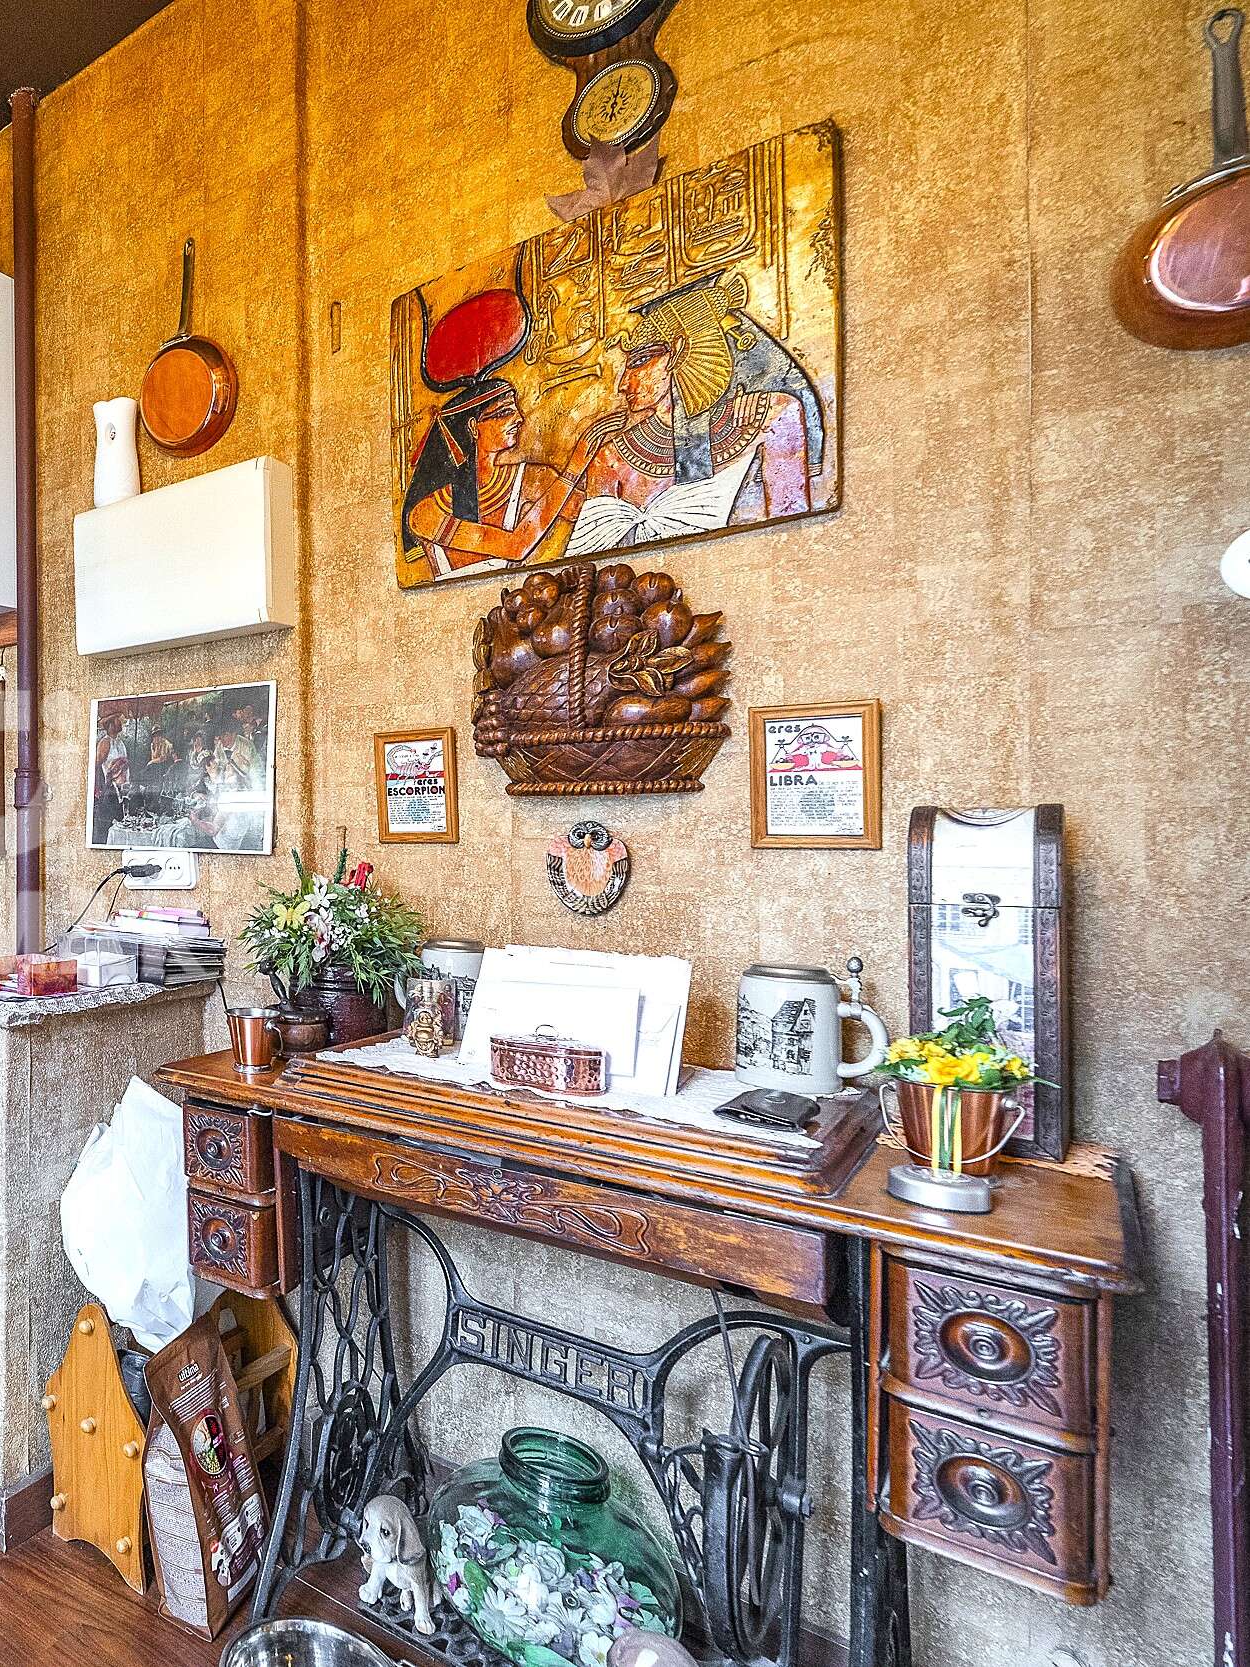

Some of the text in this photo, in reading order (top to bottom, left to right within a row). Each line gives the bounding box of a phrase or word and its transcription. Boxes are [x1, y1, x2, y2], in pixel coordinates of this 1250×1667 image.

[768, 724, 801, 734] eres
[417, 778, 438, 786] eres
[769, 774, 818, 787] LIBRA
[387, 785, 446, 797] ESCORPION
[460, 1312, 640, 1411] SINGER
